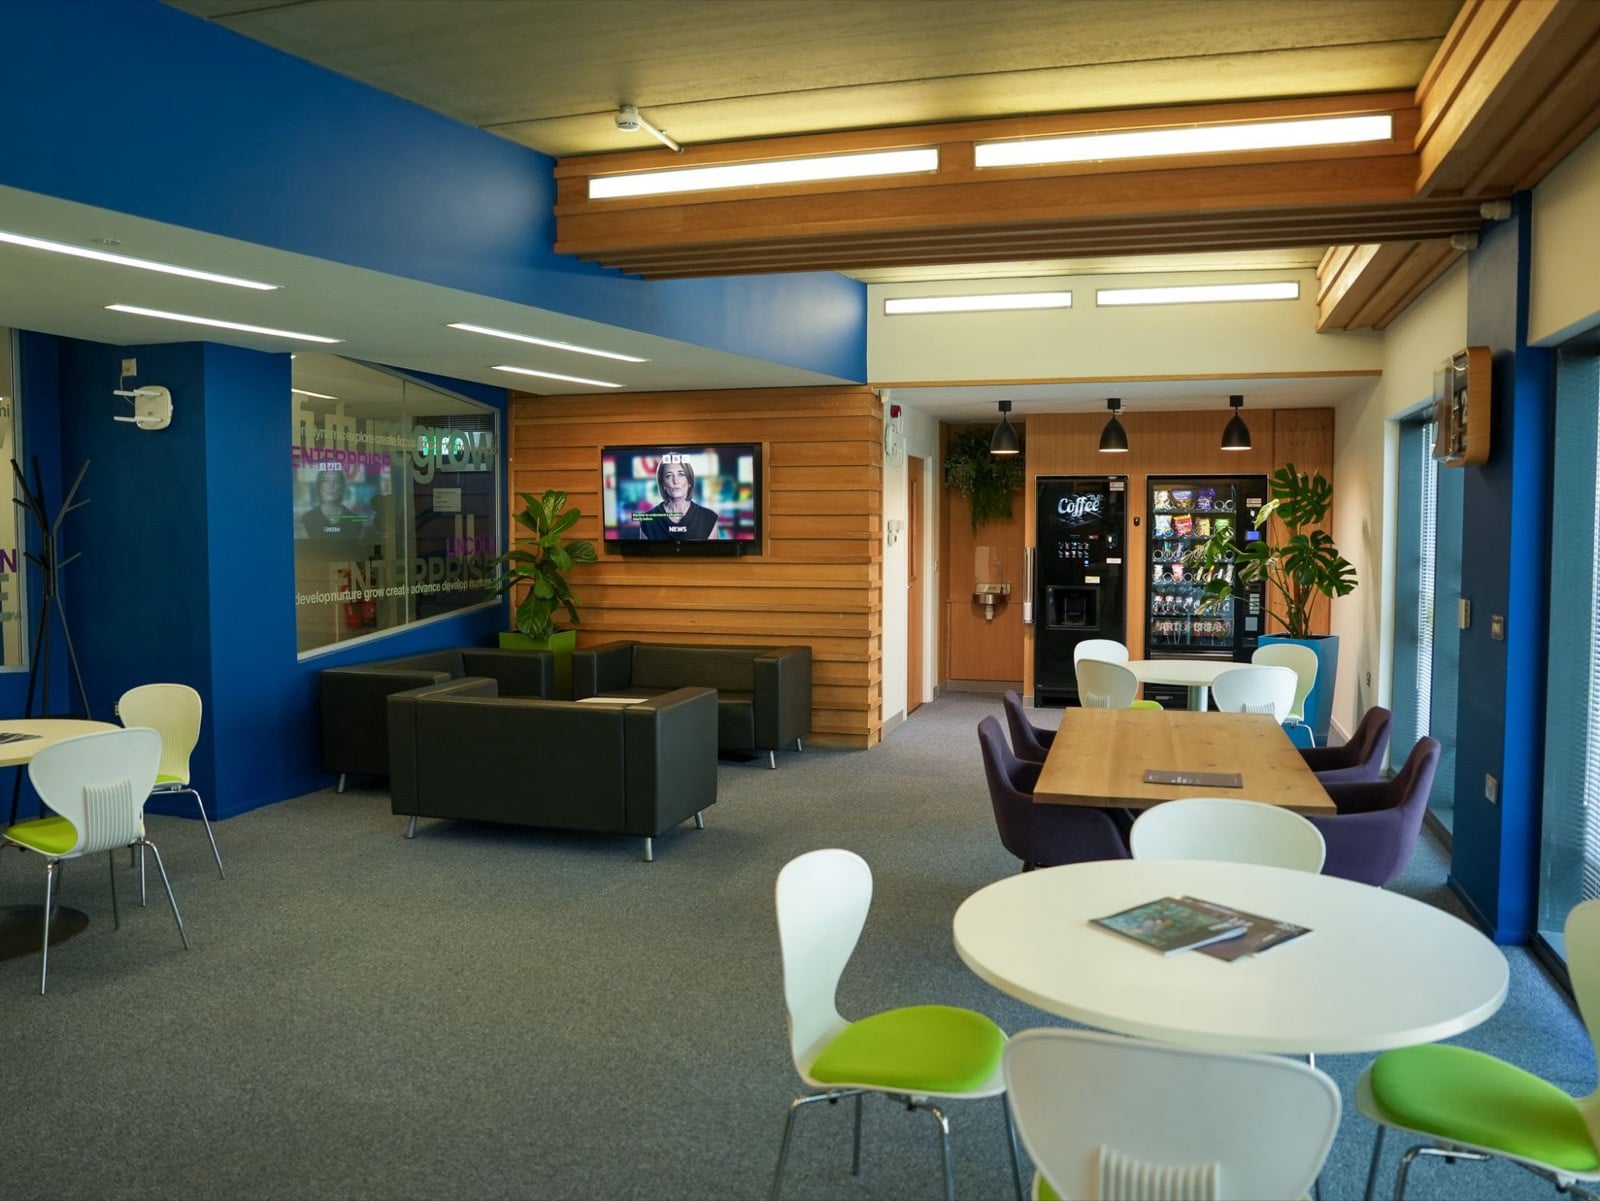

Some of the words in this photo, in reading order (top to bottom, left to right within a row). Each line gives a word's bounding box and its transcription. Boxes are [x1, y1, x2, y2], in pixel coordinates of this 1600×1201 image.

[291, 446, 392, 477] ENTERPRISE
[1058, 496, 1100, 517] Coffee
[330, 589, 362, 601] nurture
[364, 588, 385, 602] grow
[410, 581, 440, 594] advance
[442, 578, 468, 592] develop
